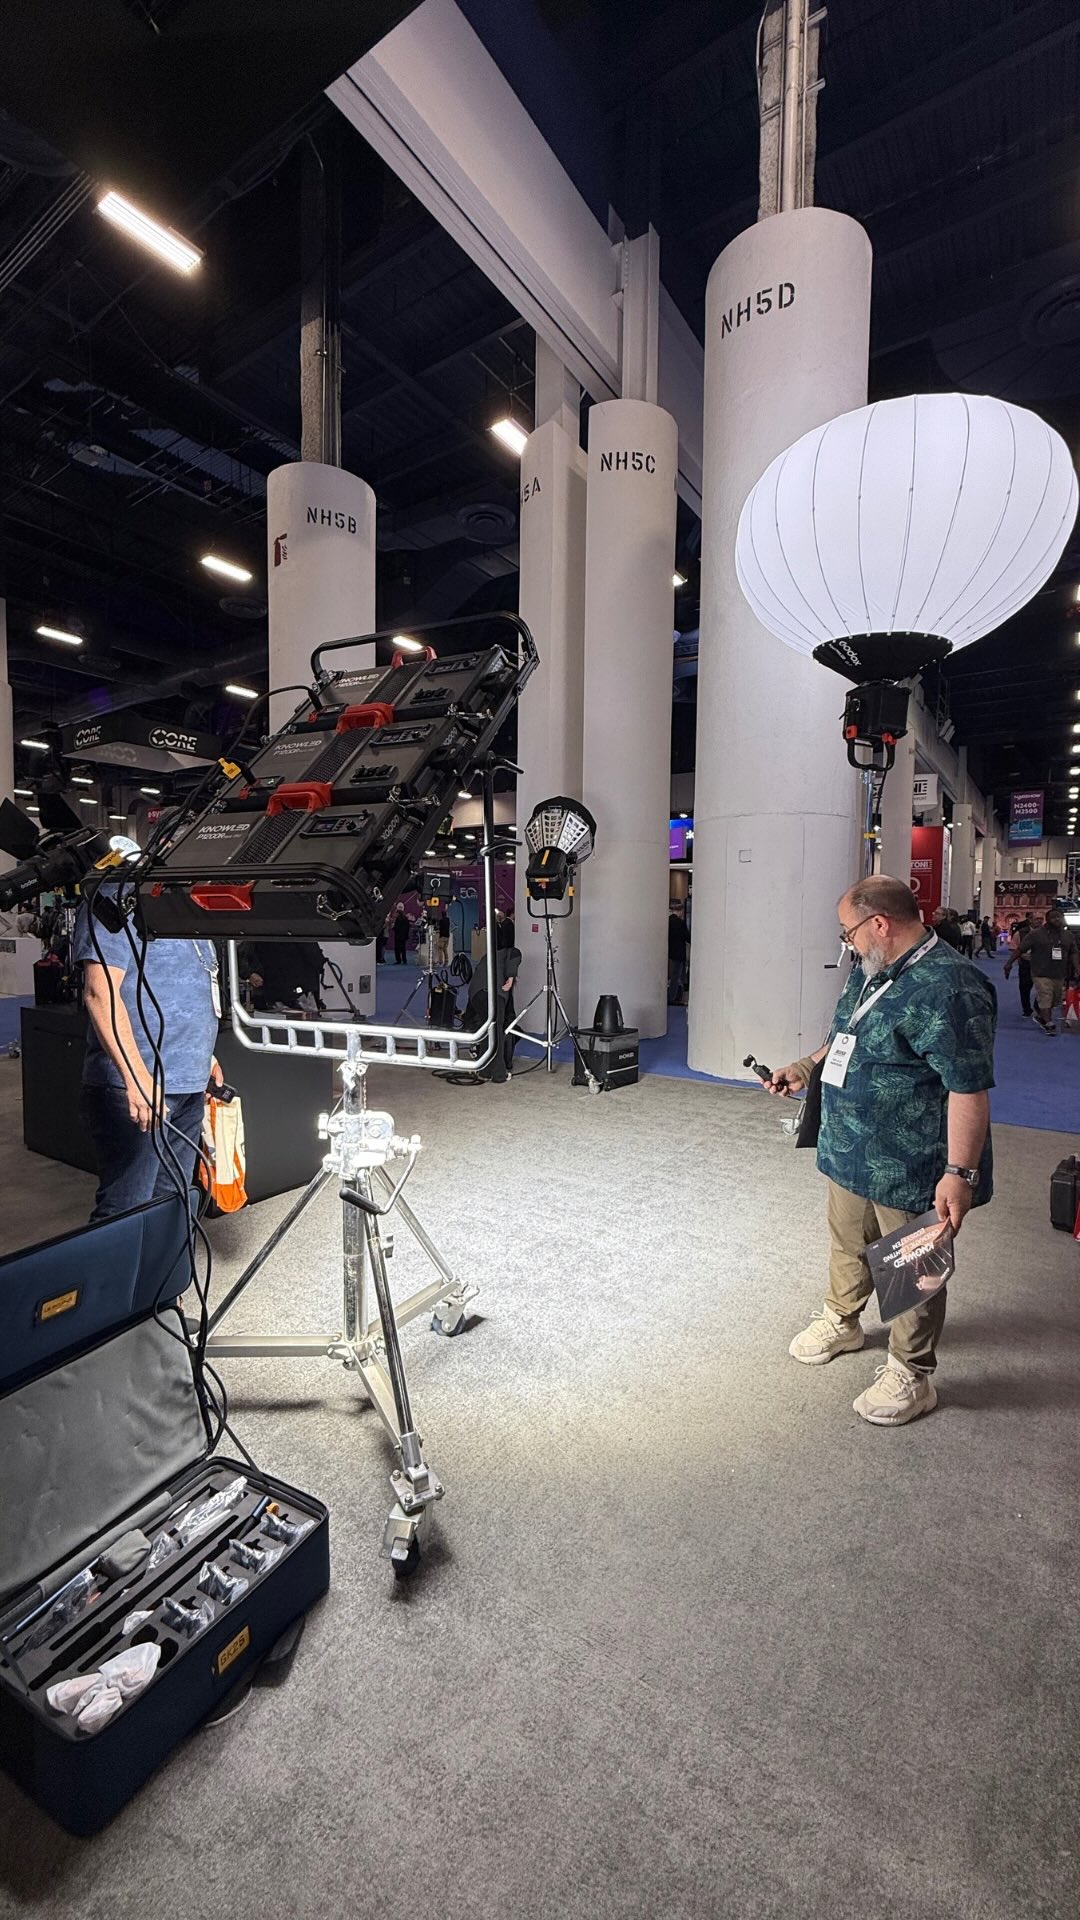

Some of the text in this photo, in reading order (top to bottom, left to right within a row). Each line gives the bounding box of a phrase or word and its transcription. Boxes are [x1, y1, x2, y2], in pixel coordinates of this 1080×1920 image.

[721, 282, 796, 340] NH5D
[600, 451, 656, 474] NH5C
[520, 476, 541, 505] 5A
[306, 506, 357, 534] NH5B
[74, 725, 102, 750] CORE
[149, 727, 198, 753] CORE
[198, 823, 250, 833] KNOWLED
[893, 1241, 935, 1269] KNOWLED
